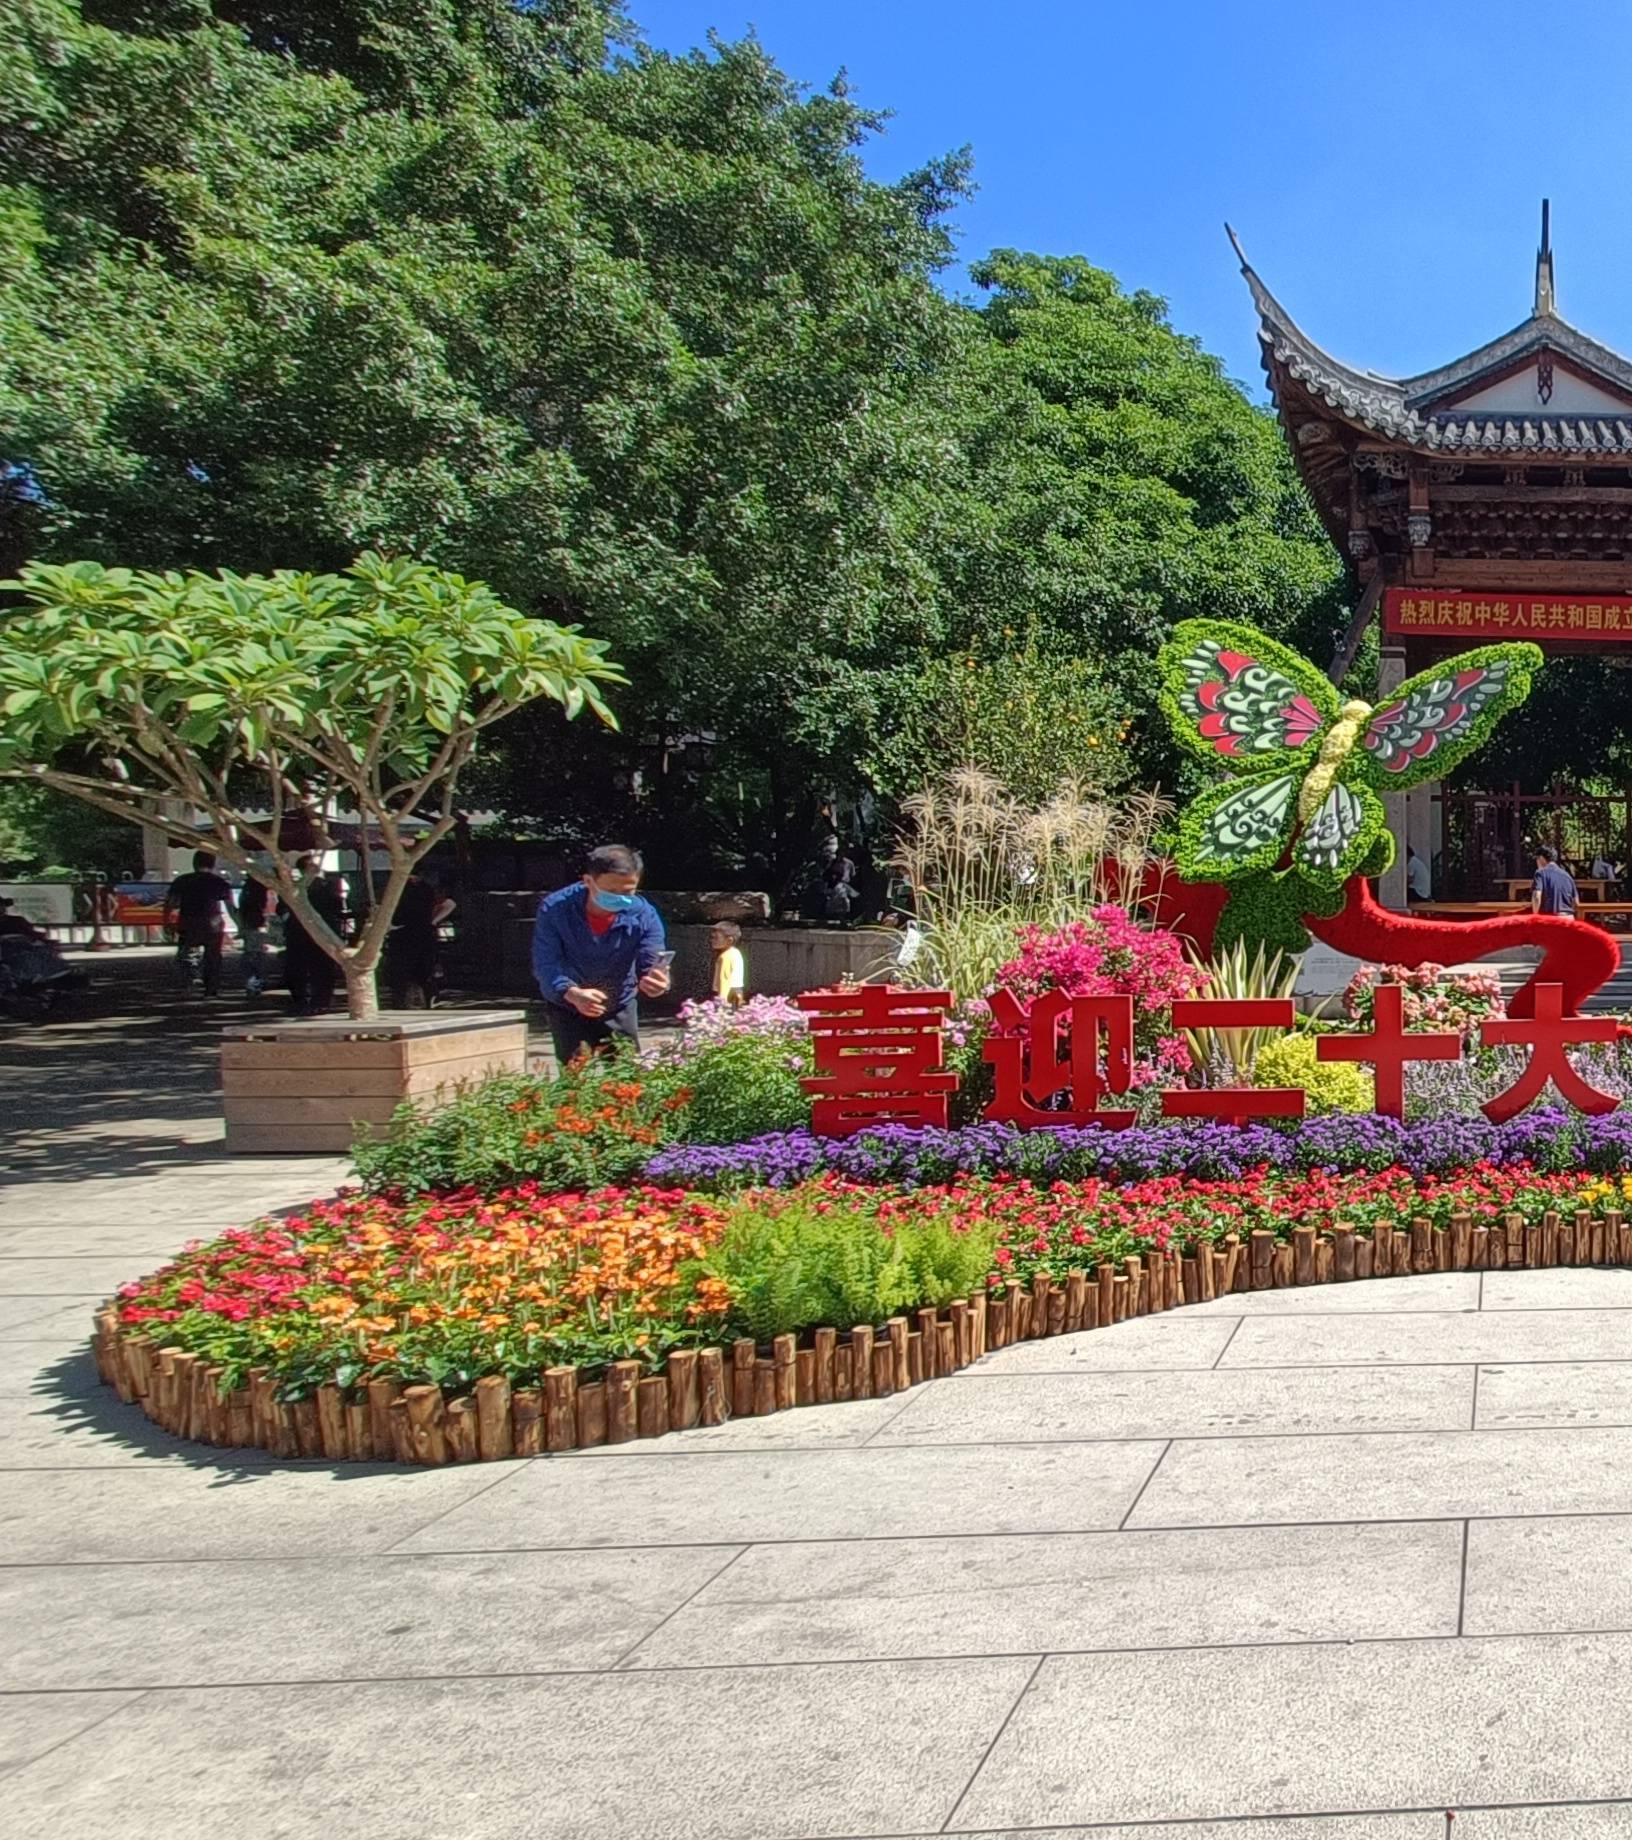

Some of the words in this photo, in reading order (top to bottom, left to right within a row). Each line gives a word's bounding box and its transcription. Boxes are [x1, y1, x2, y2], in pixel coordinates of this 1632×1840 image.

[801, 982, 1620, 1137] 喜迎二十大
